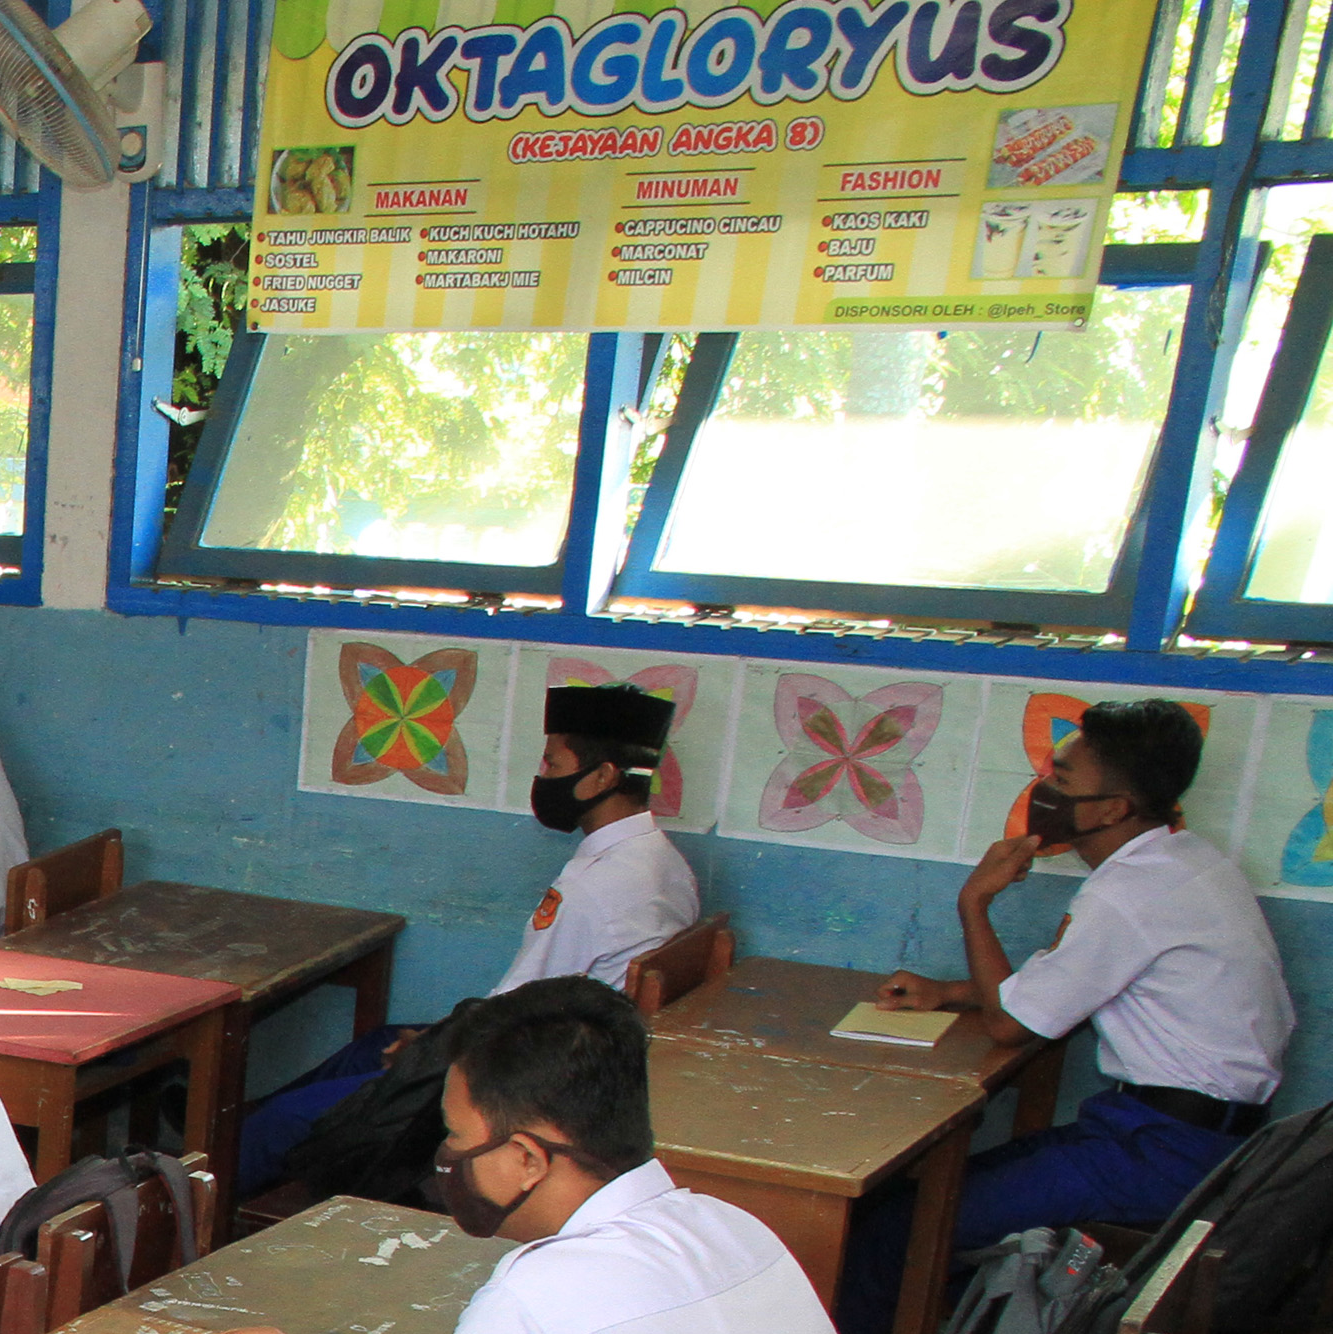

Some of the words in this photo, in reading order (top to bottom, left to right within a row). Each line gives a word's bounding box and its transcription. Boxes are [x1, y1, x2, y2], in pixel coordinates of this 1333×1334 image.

[328, 0, 1066, 124] OKTAGLORYUS
[509, 126, 661, 163] (KEJAYAAN
[669, 120, 776, 156] ANGKA
[786, 117, 824, 151] 8)
[636, 177, 739, 200] MINUMAN
[840, 168, 942, 192] FASHION
[375, 188, 469, 209] MAKANAN
[624, 217, 715, 238] CAPPUCINO
[718, 215, 782, 235] CINCAU
[832, 212, 881, 232] KAOS
[883, 210, 929, 230] KAKI
[268, 230, 306, 246] TAHU
[308, 228, 368, 245] JUNGKIR
[370, 226, 411, 244] BALIK
[429, 225, 471, 242] KUCH
[473, 224, 515, 241] KUCH
[517, 221, 580, 240] HOTAHU
[426, 248, 503, 266] MAKARONI
[620, 243, 708, 261] MARCONAT
[827, 238, 875, 257] BAJU
[265, 253, 318, 269] SOSTEL
[263, 275, 305, 291] FRIED
[307, 274, 362, 290] NUGGET
[512, 271, 541, 288] MIE
[616, 269, 673, 287] MILCIN
[822, 264, 894, 283] PARFUM
[260, 298, 317, 313] JASUKE
[834, 304, 928, 319] DISPONSORI
[933, 303, 974, 317] OLEH
